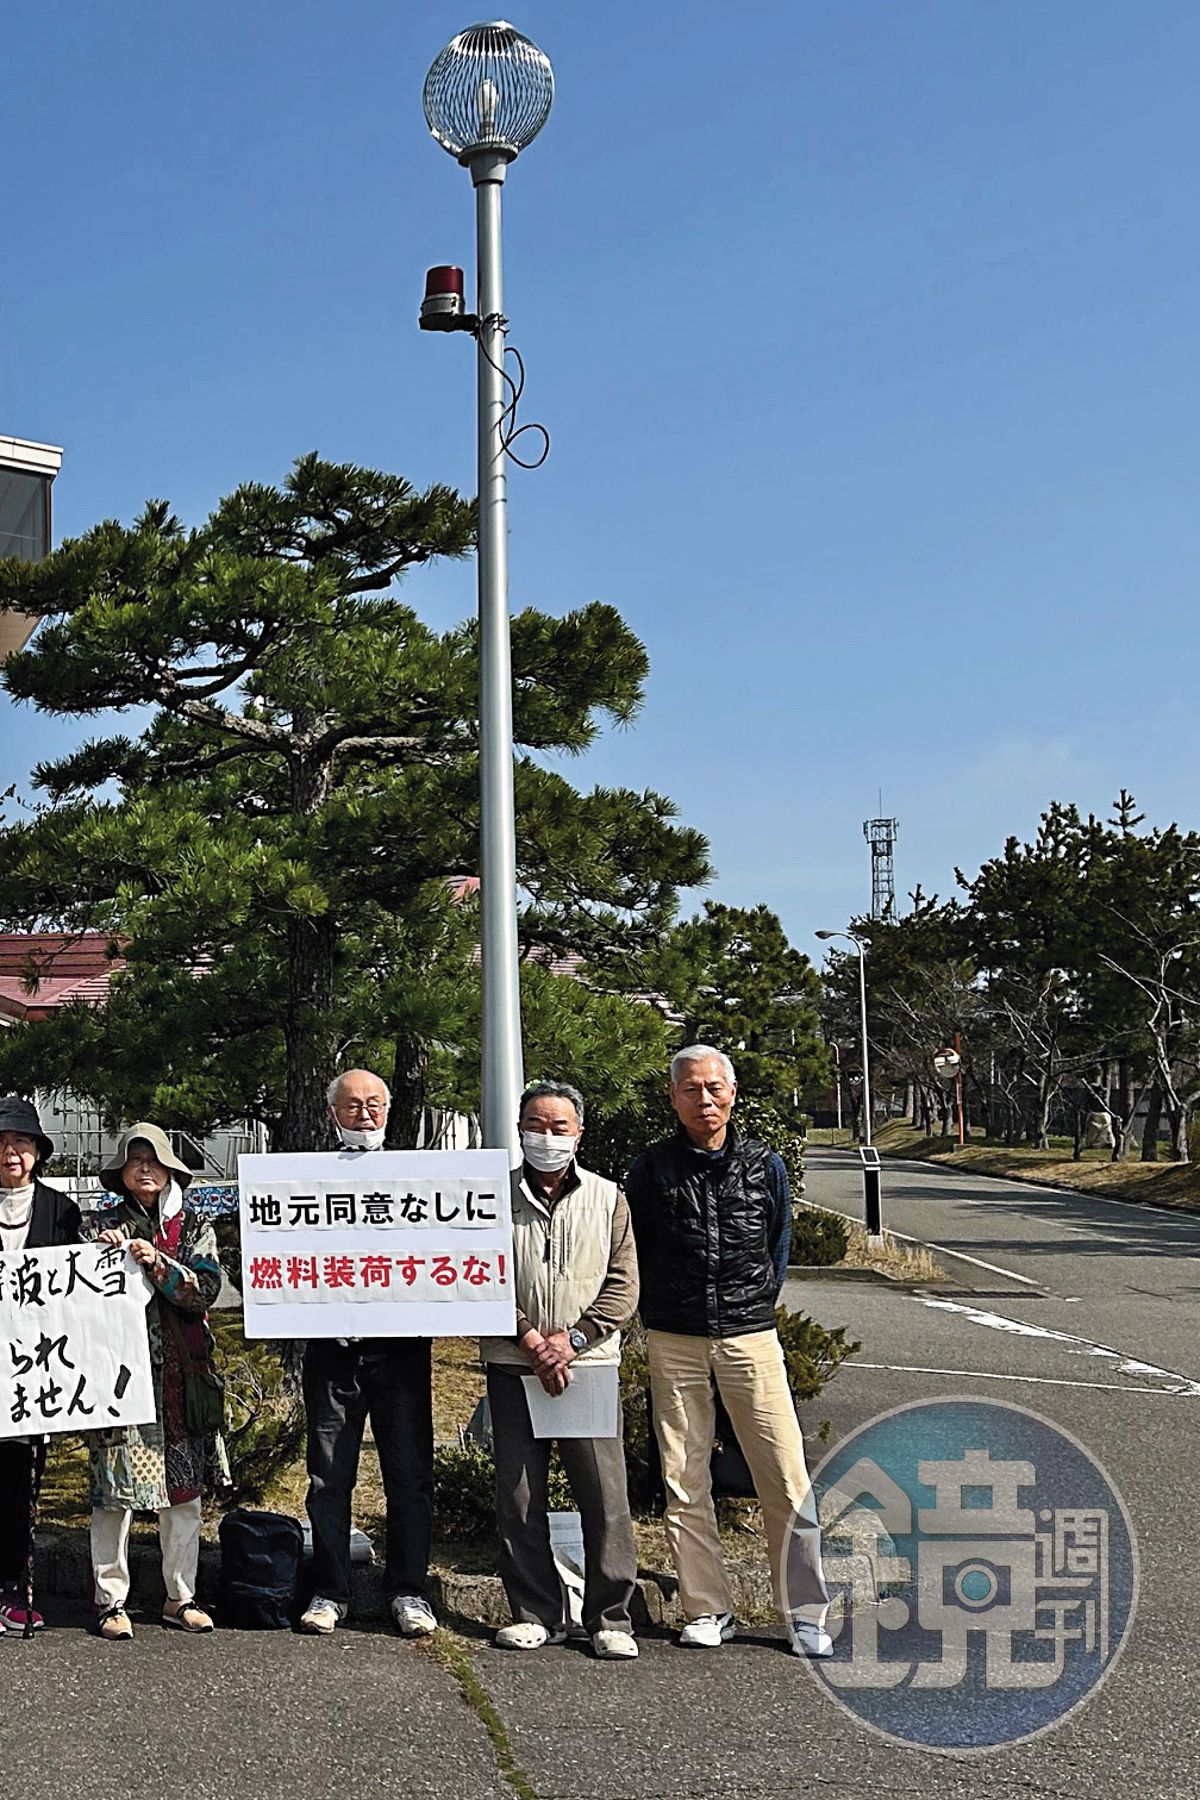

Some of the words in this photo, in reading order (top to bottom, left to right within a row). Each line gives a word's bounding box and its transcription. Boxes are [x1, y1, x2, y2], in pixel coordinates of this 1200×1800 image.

[249, 1190, 497, 1226] 地元同意なしに
[249, 1255, 506, 1289] 燃料装荷するな!
